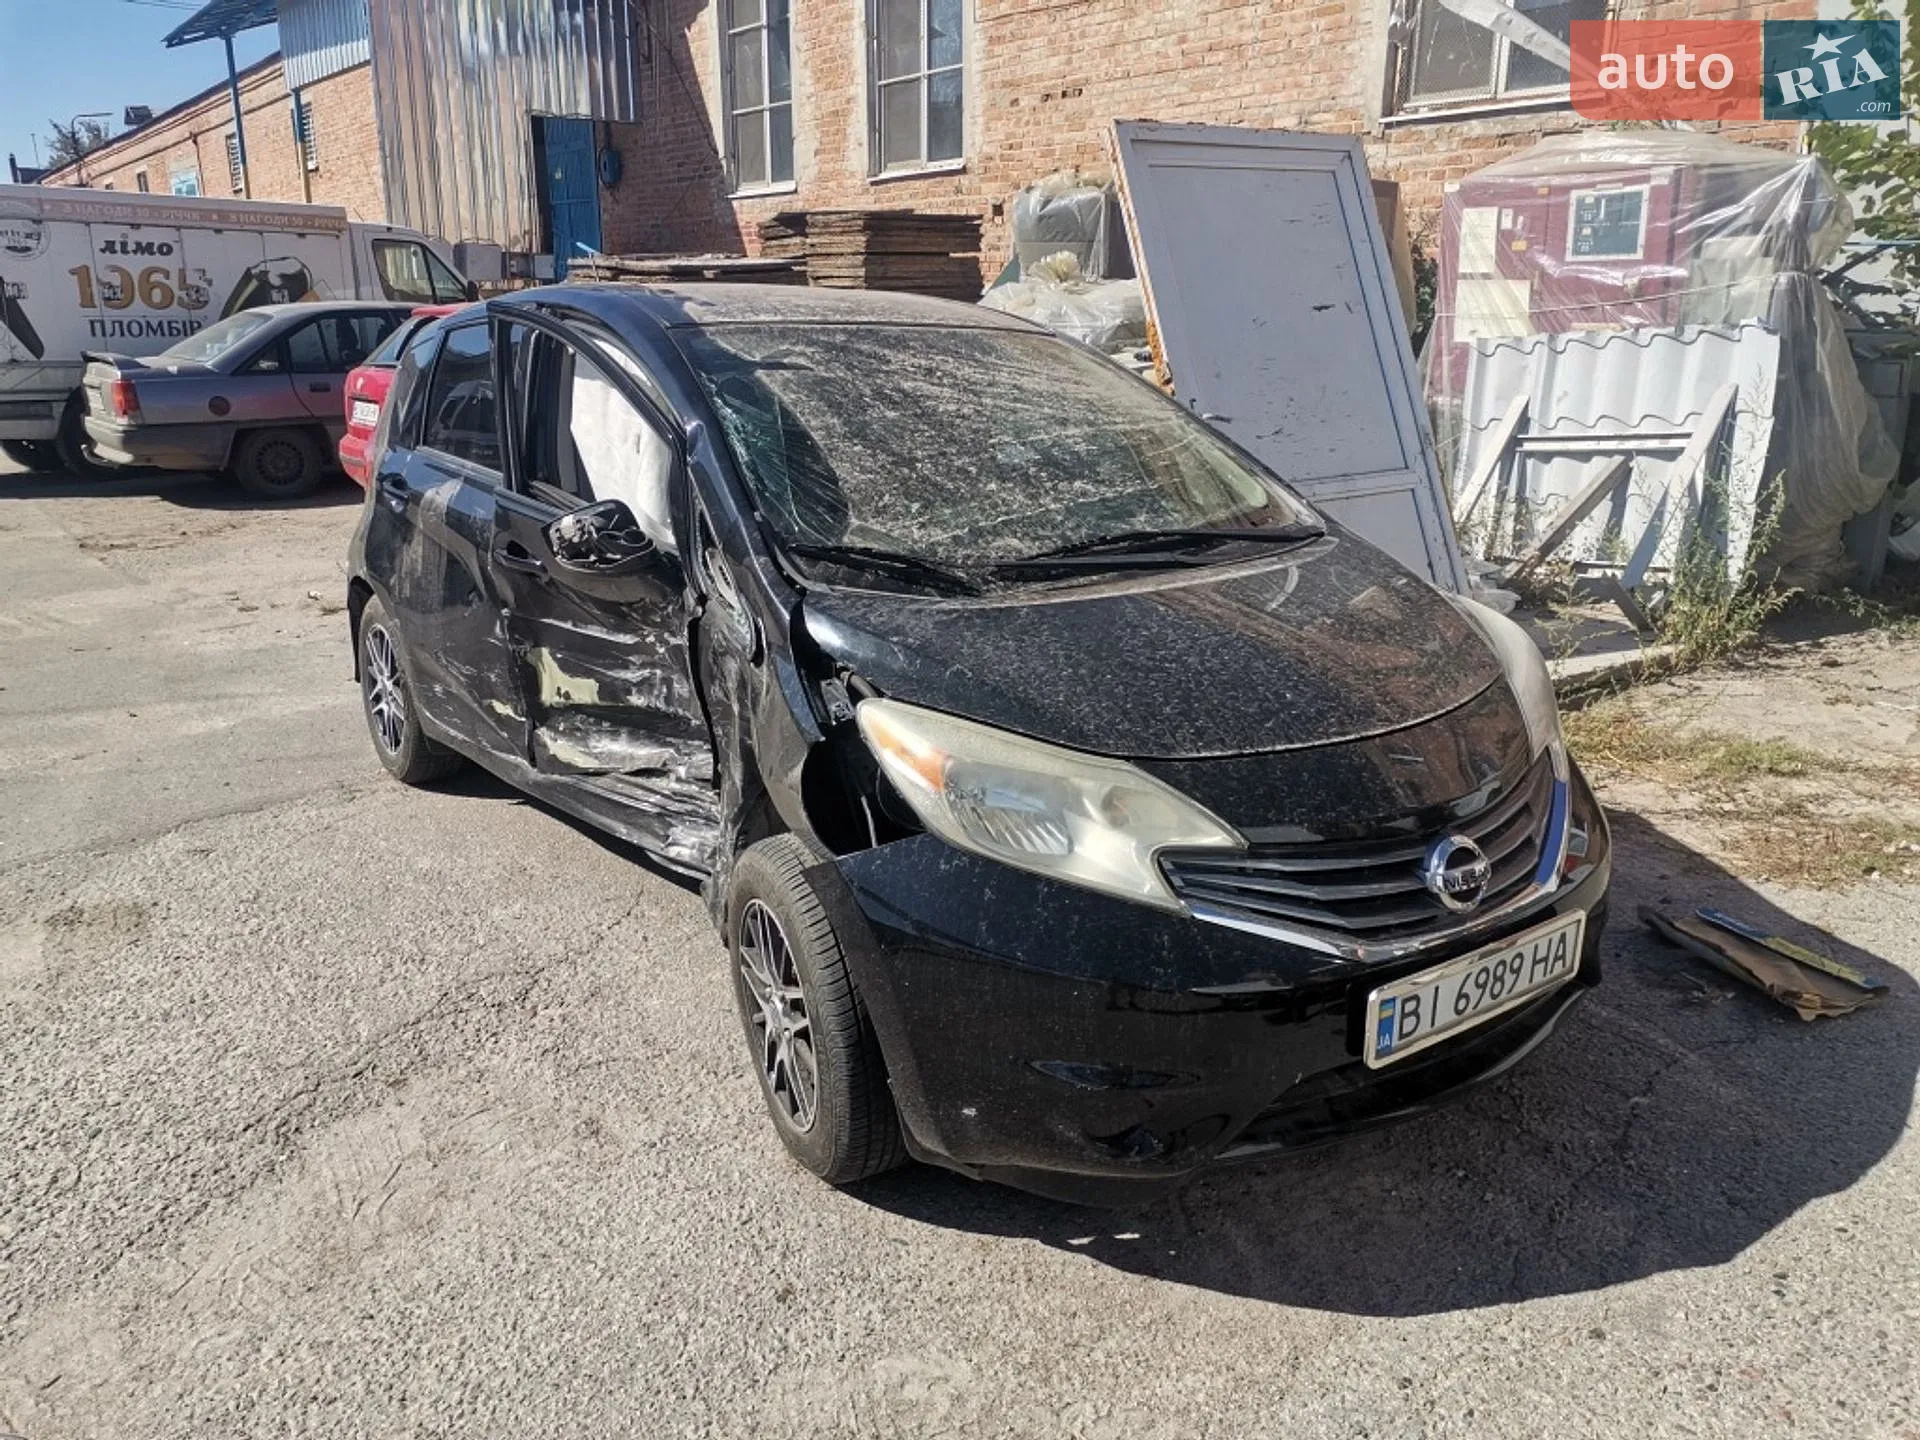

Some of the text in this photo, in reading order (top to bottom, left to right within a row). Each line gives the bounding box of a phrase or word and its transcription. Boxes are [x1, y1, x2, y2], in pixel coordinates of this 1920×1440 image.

[1400, 932, 1567, 1040] BI 6989 HA
